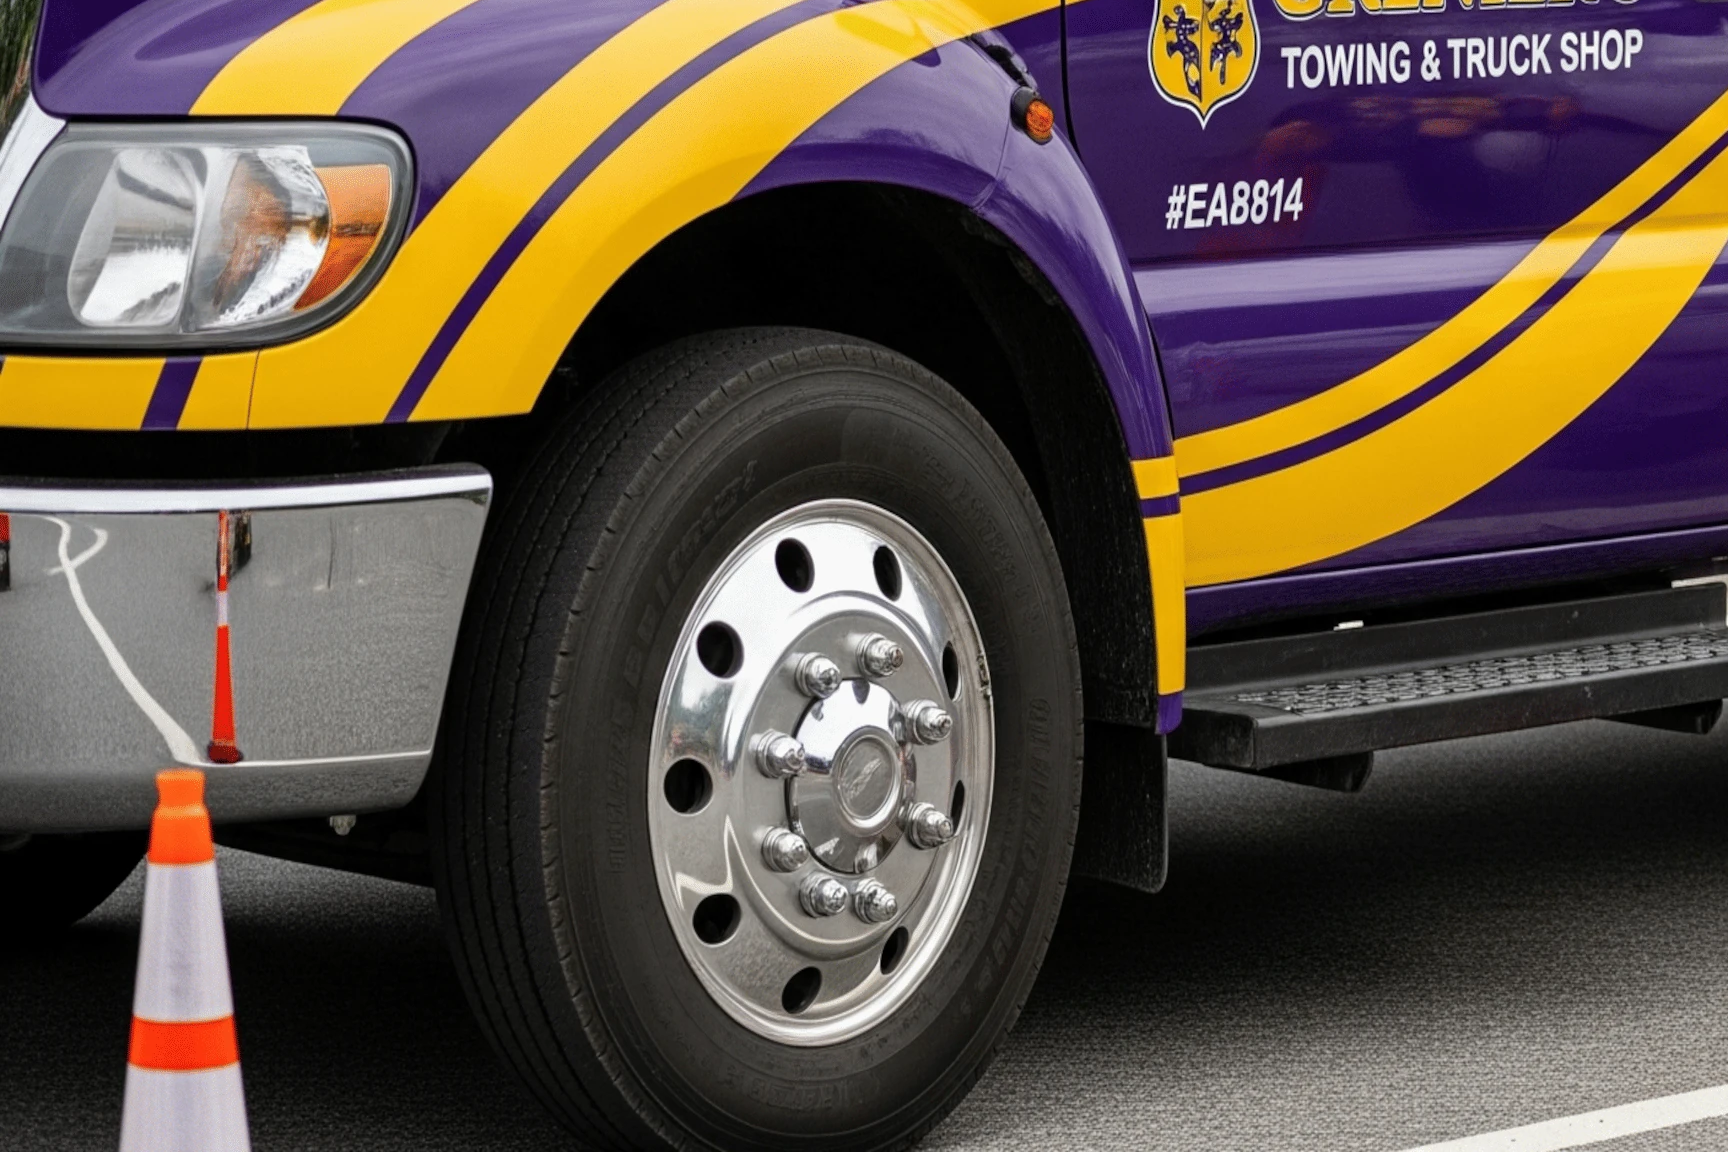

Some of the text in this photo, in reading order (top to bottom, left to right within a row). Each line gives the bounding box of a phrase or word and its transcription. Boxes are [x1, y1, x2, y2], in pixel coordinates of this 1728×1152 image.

[1281, 28, 1644, 89] TOWING & TRUCK SHOP
[1164, 176, 1304, 230] #EA8814
